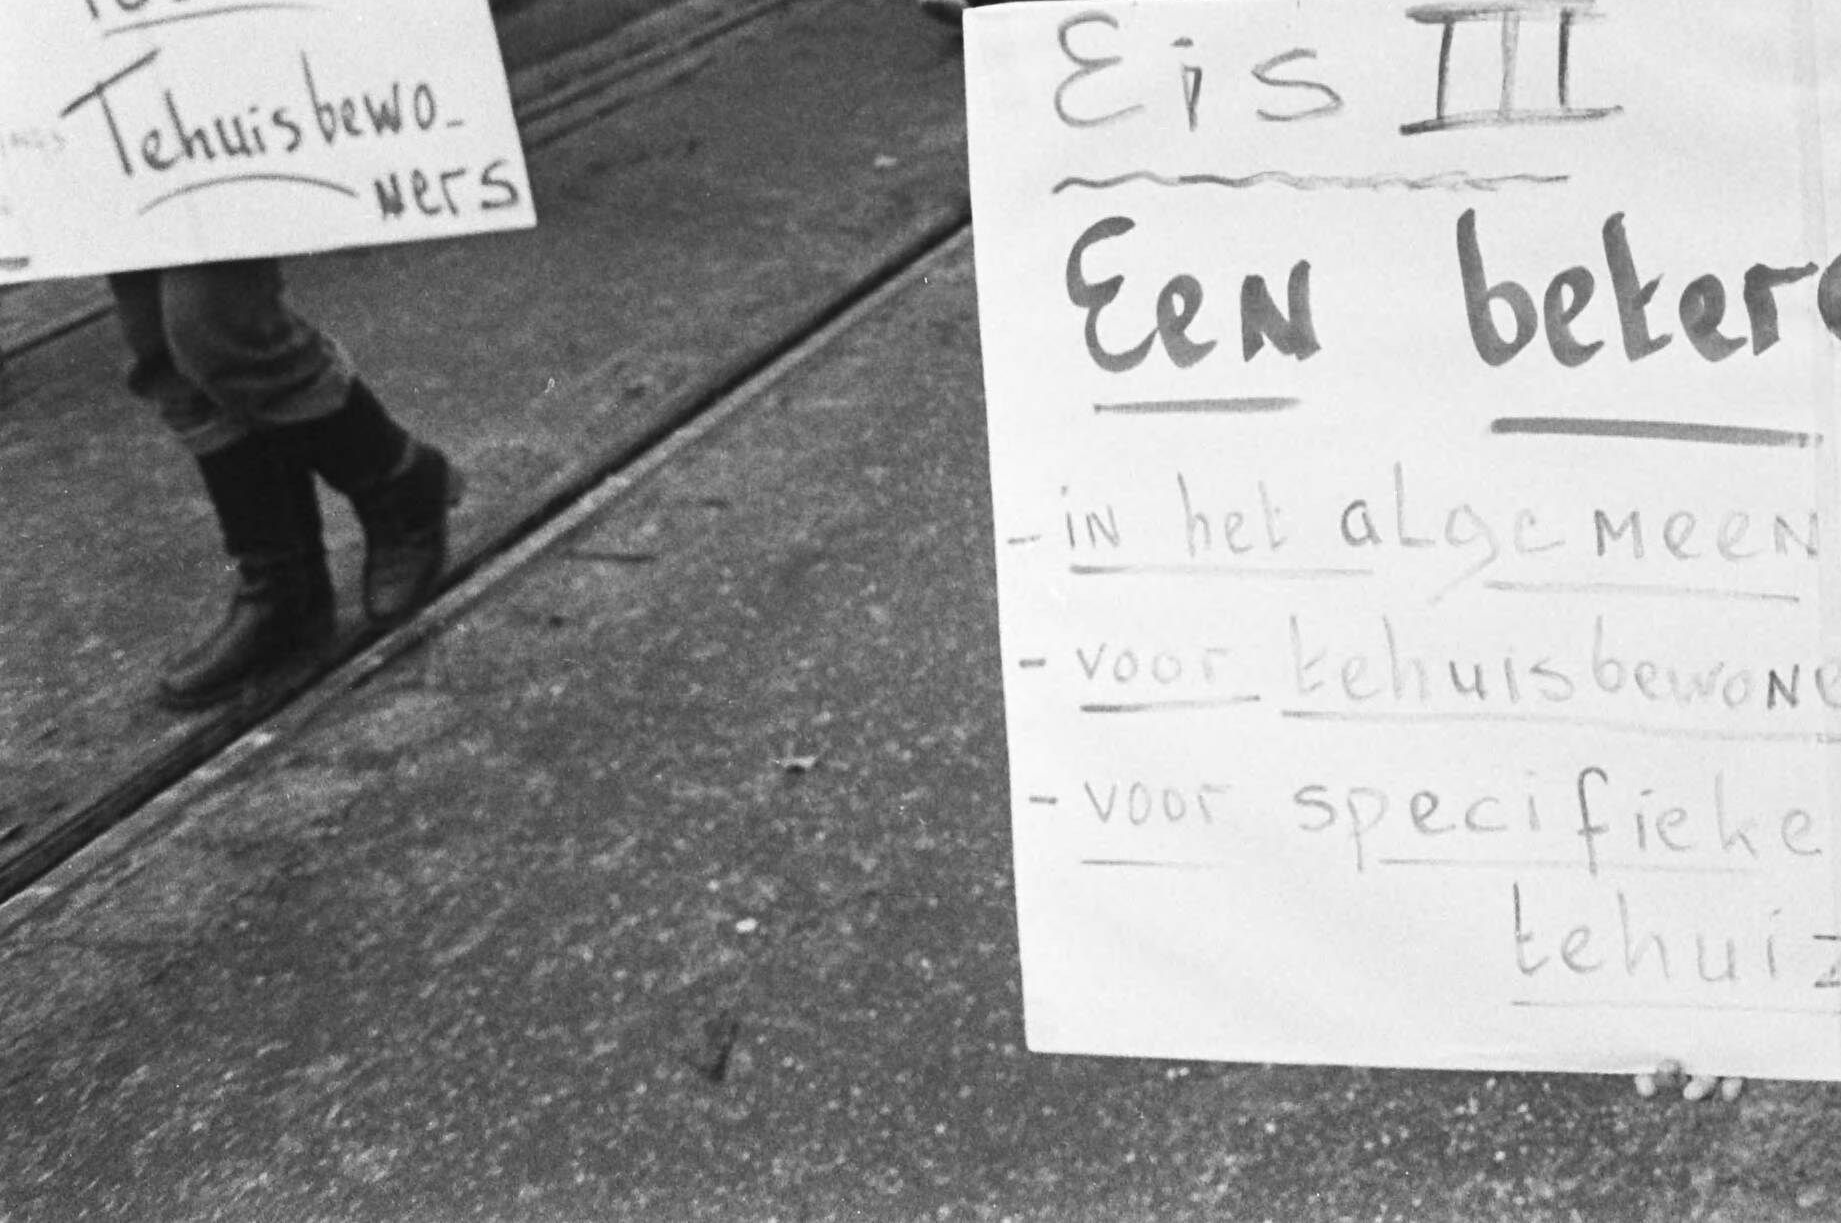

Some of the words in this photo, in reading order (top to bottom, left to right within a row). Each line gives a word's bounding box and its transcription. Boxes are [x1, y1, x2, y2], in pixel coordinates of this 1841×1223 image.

[1055, 10, 1343, 132] Eis
[1178, 473, 1287, 556] het
[1294, 767, 1824, 877] specifieke
